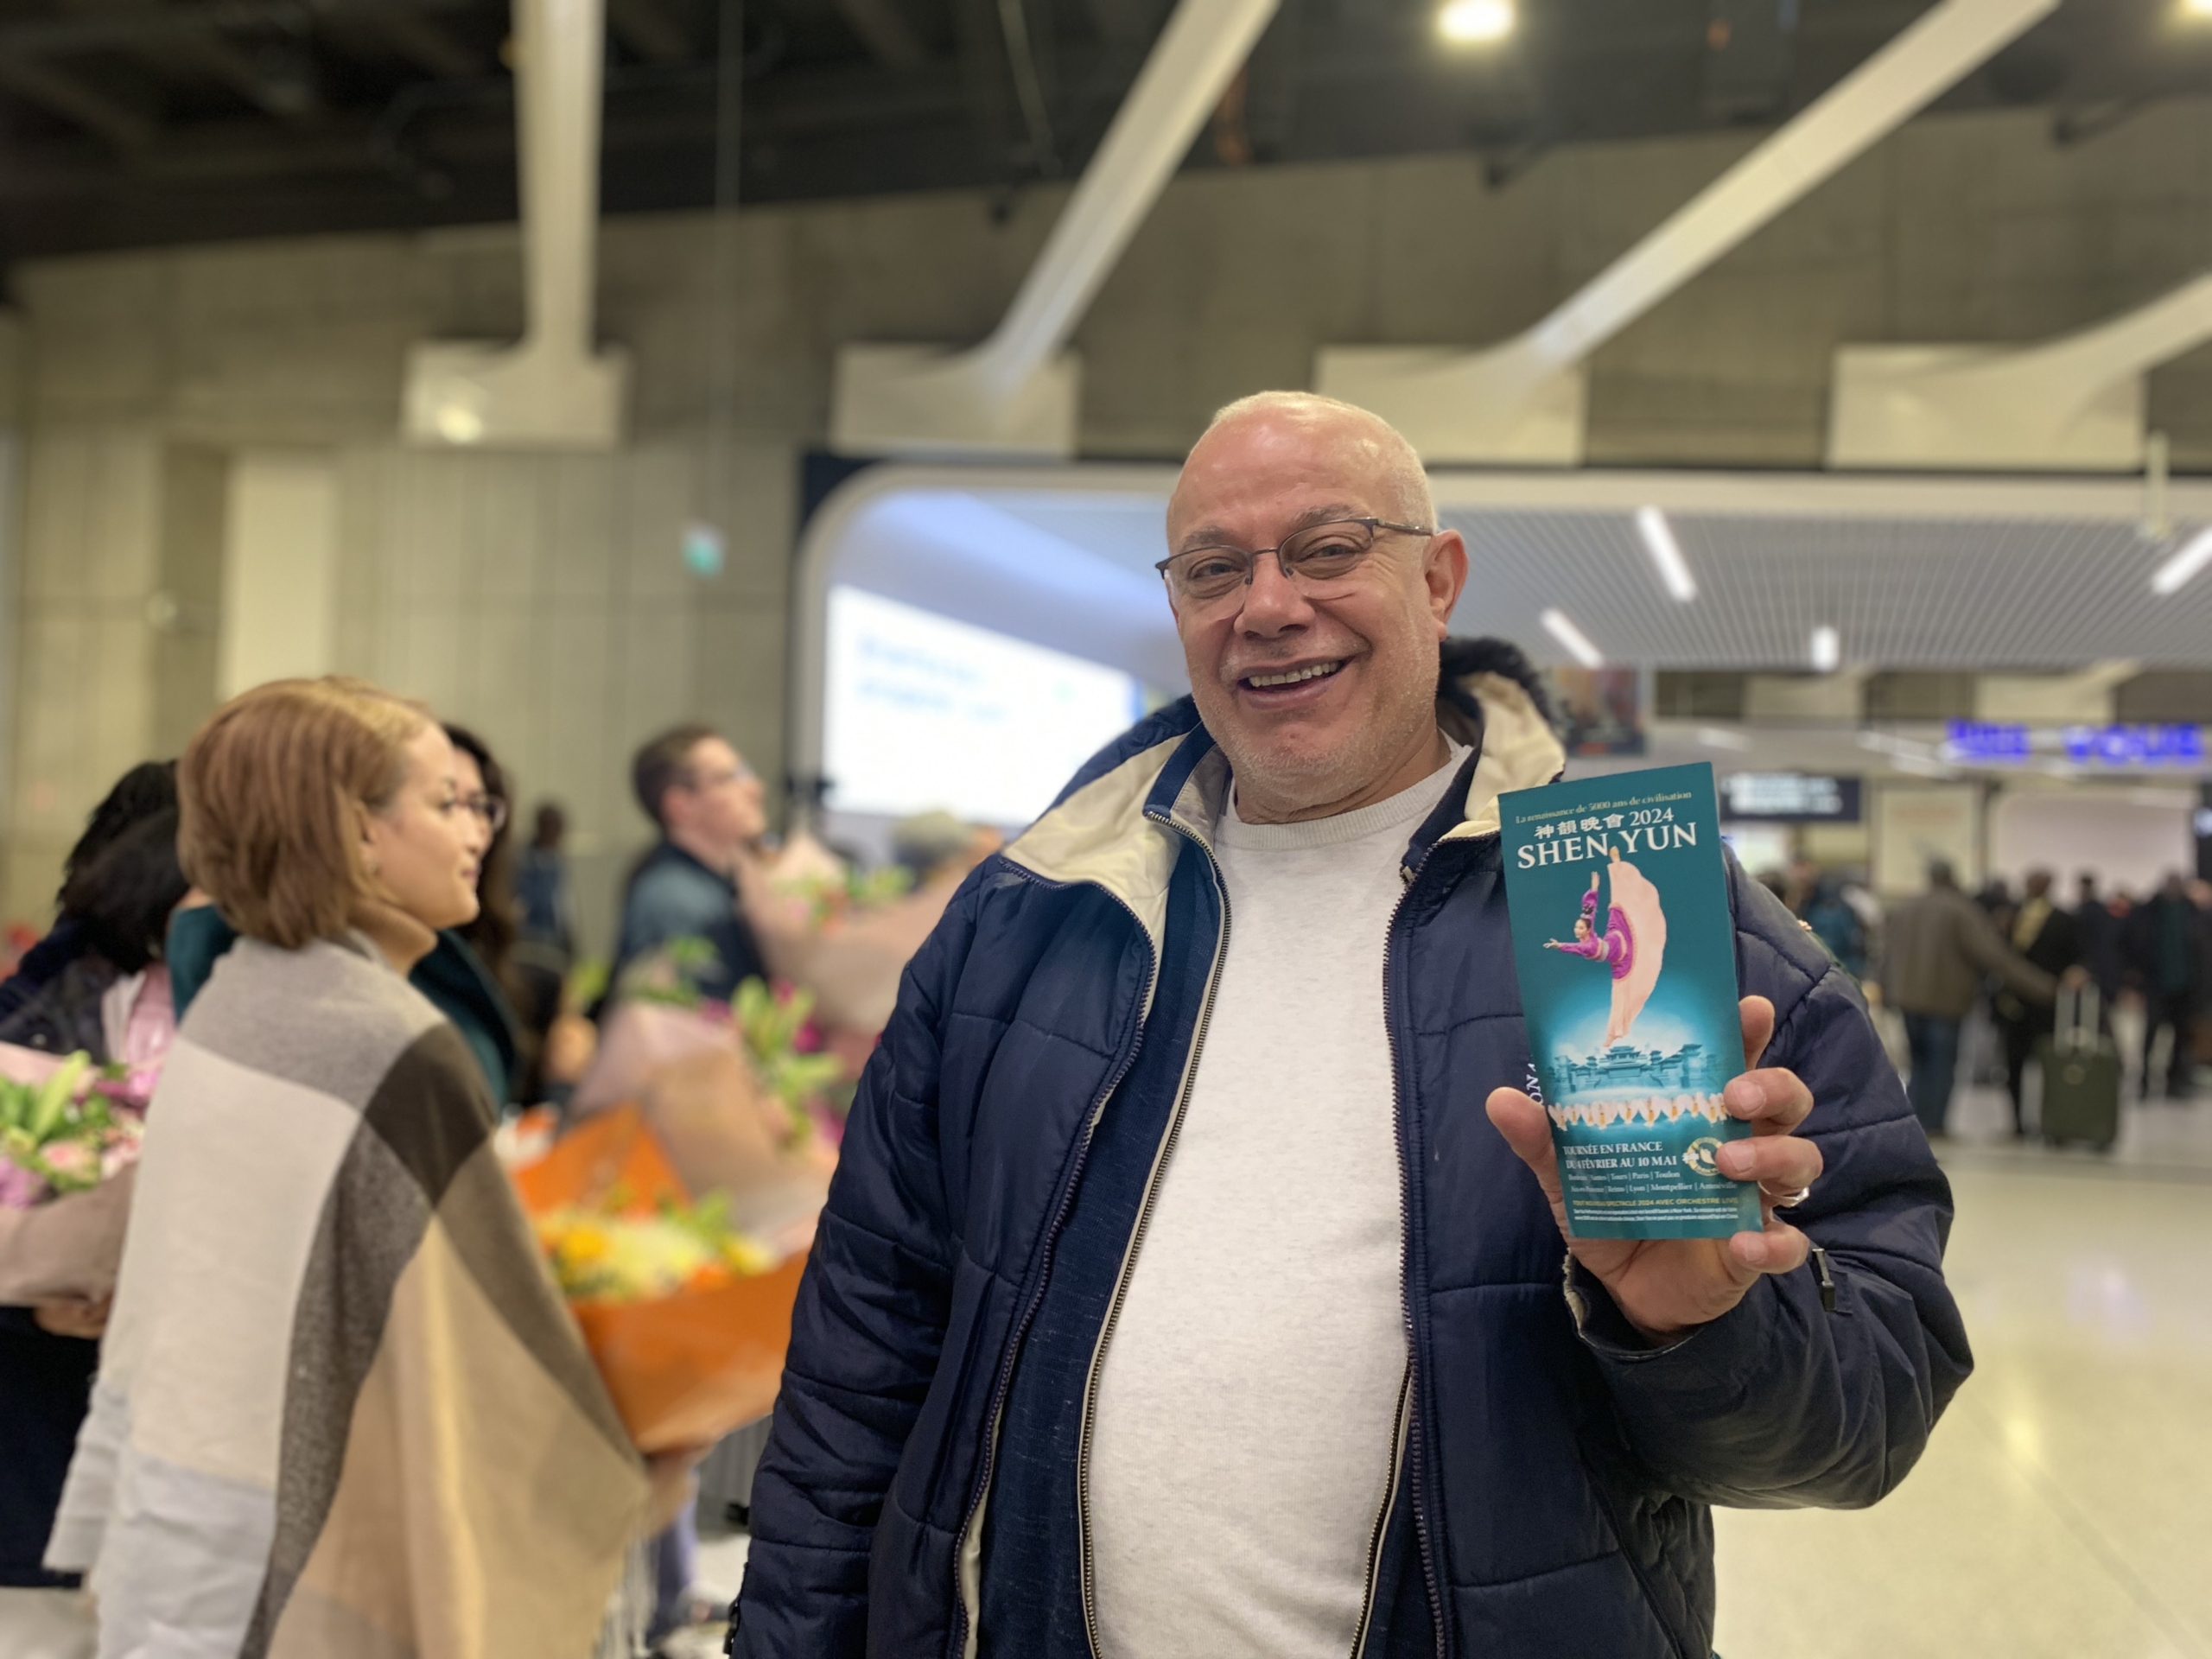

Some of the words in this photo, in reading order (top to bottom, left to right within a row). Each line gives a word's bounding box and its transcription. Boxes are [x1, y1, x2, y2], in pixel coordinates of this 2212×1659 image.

[1516, 815, 1527, 823] La
[1527, 808, 1575, 822] renaissance
[1576, 804, 1586, 813] de
[1588, 800, 1611, 812] 5000
[1612, 799, 1628, 809] ans
[1629, 797, 1641, 805] de
[1642, 791, 1692, 804] civilisation
[1629, 807, 1674, 827] 2024
[1517, 832, 1608, 869] SHEN
[1618, 822, 1697, 854] YUN
[1562, 1143, 1599, 1155] TOURNÉE
[1599, 1144, 1614, 1154] EN
[1615, 1141, 1663, 1154] FRANCE
[1581, 1157, 1618, 1169] FÉVRIER
[1619, 1158, 1636, 1168] AU
[1637, 1157, 1649, 1166] 10
[1651, 1155, 1677, 1166] MAI
[1632, 1172, 1649, 1180] Paris
[1629, 1185, 1646, 1194] Lyon
[1650, 1182, 1693, 1192] Montpellier
[1675, 1197, 1720, 1205] ORCHESTRE
